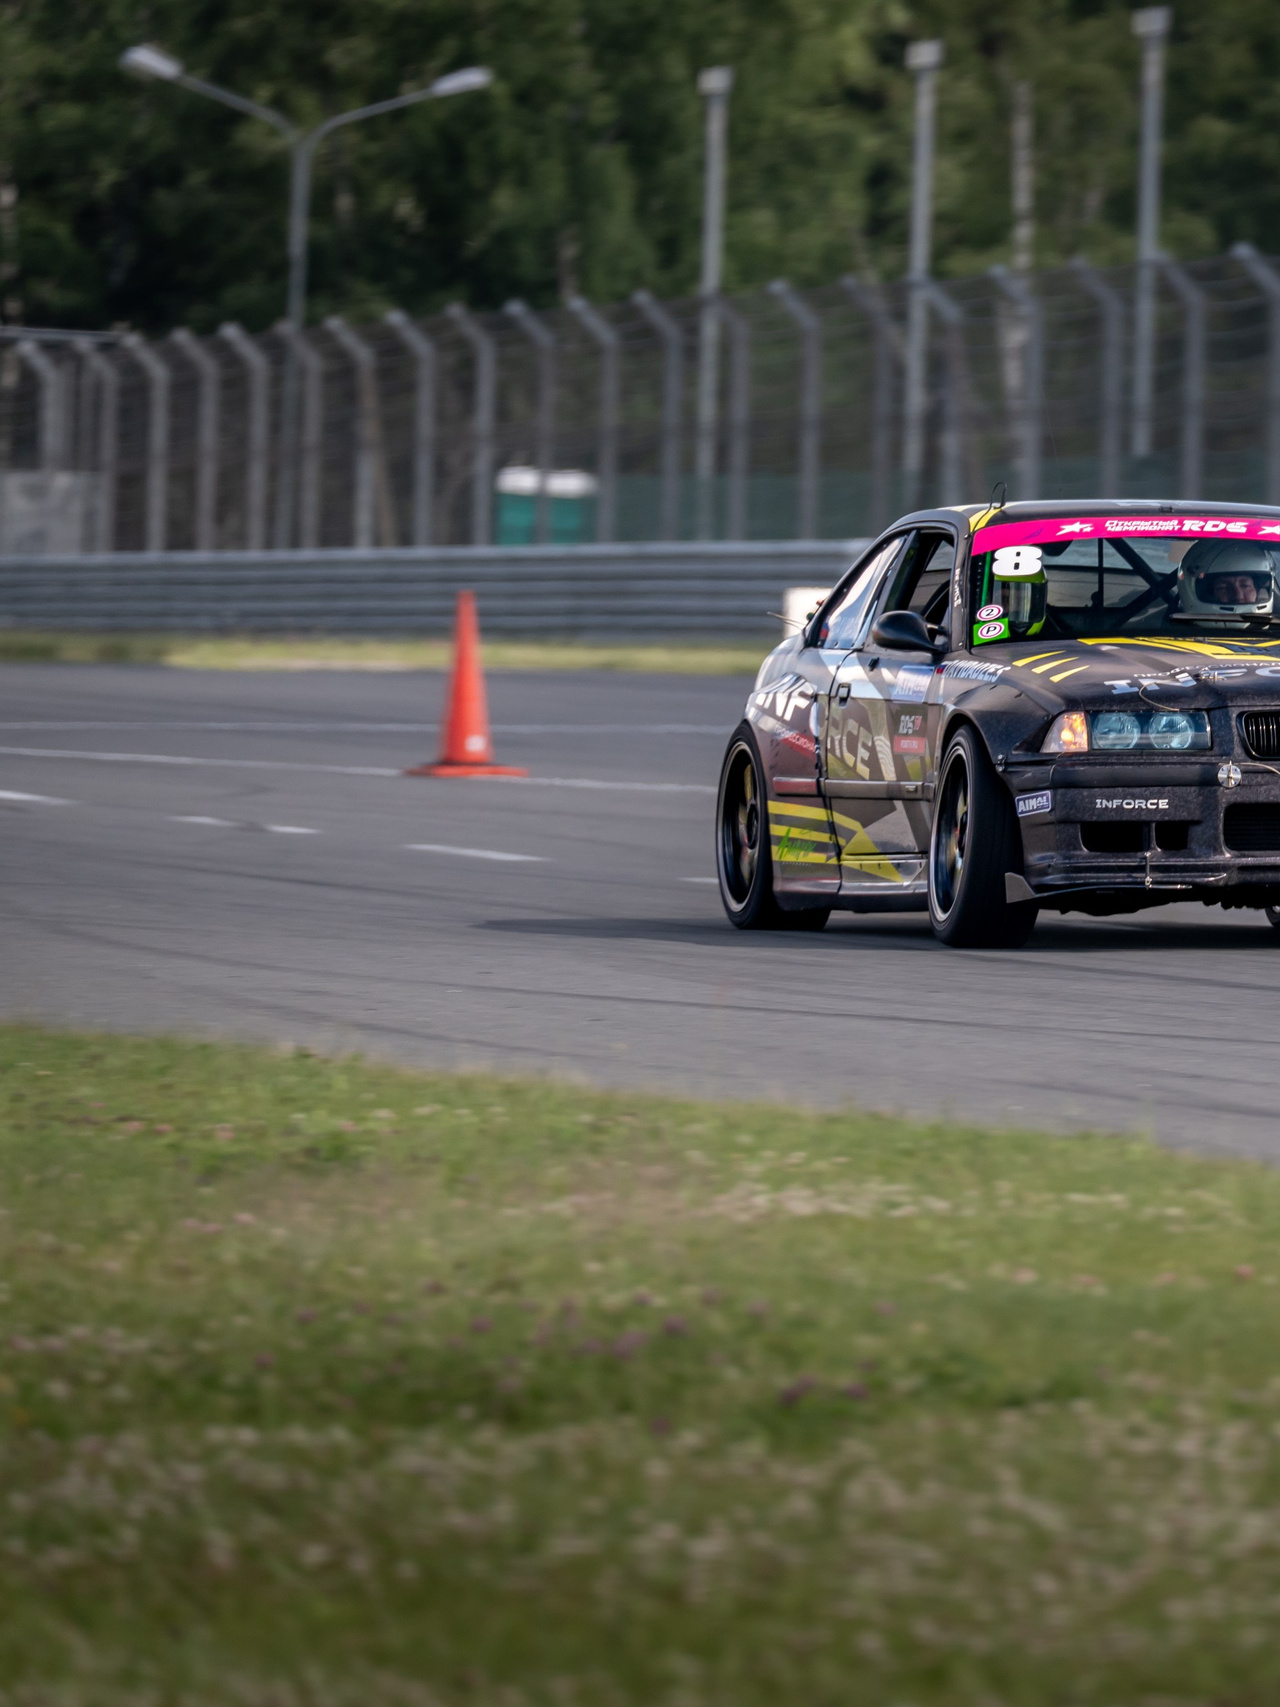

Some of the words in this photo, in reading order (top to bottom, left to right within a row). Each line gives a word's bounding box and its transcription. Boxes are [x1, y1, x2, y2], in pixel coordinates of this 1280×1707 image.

[1105, 519, 1178, 527] ОТКРЫТЫЙ
[1107, 524, 1181, 532] ЧЕМПИОНАТ
[992, 545, 1042, 576] 8
[985, 608, 995, 617] 2
[985, 626, 997, 635] P
[1096, 799, 1169, 809] INFORCE
